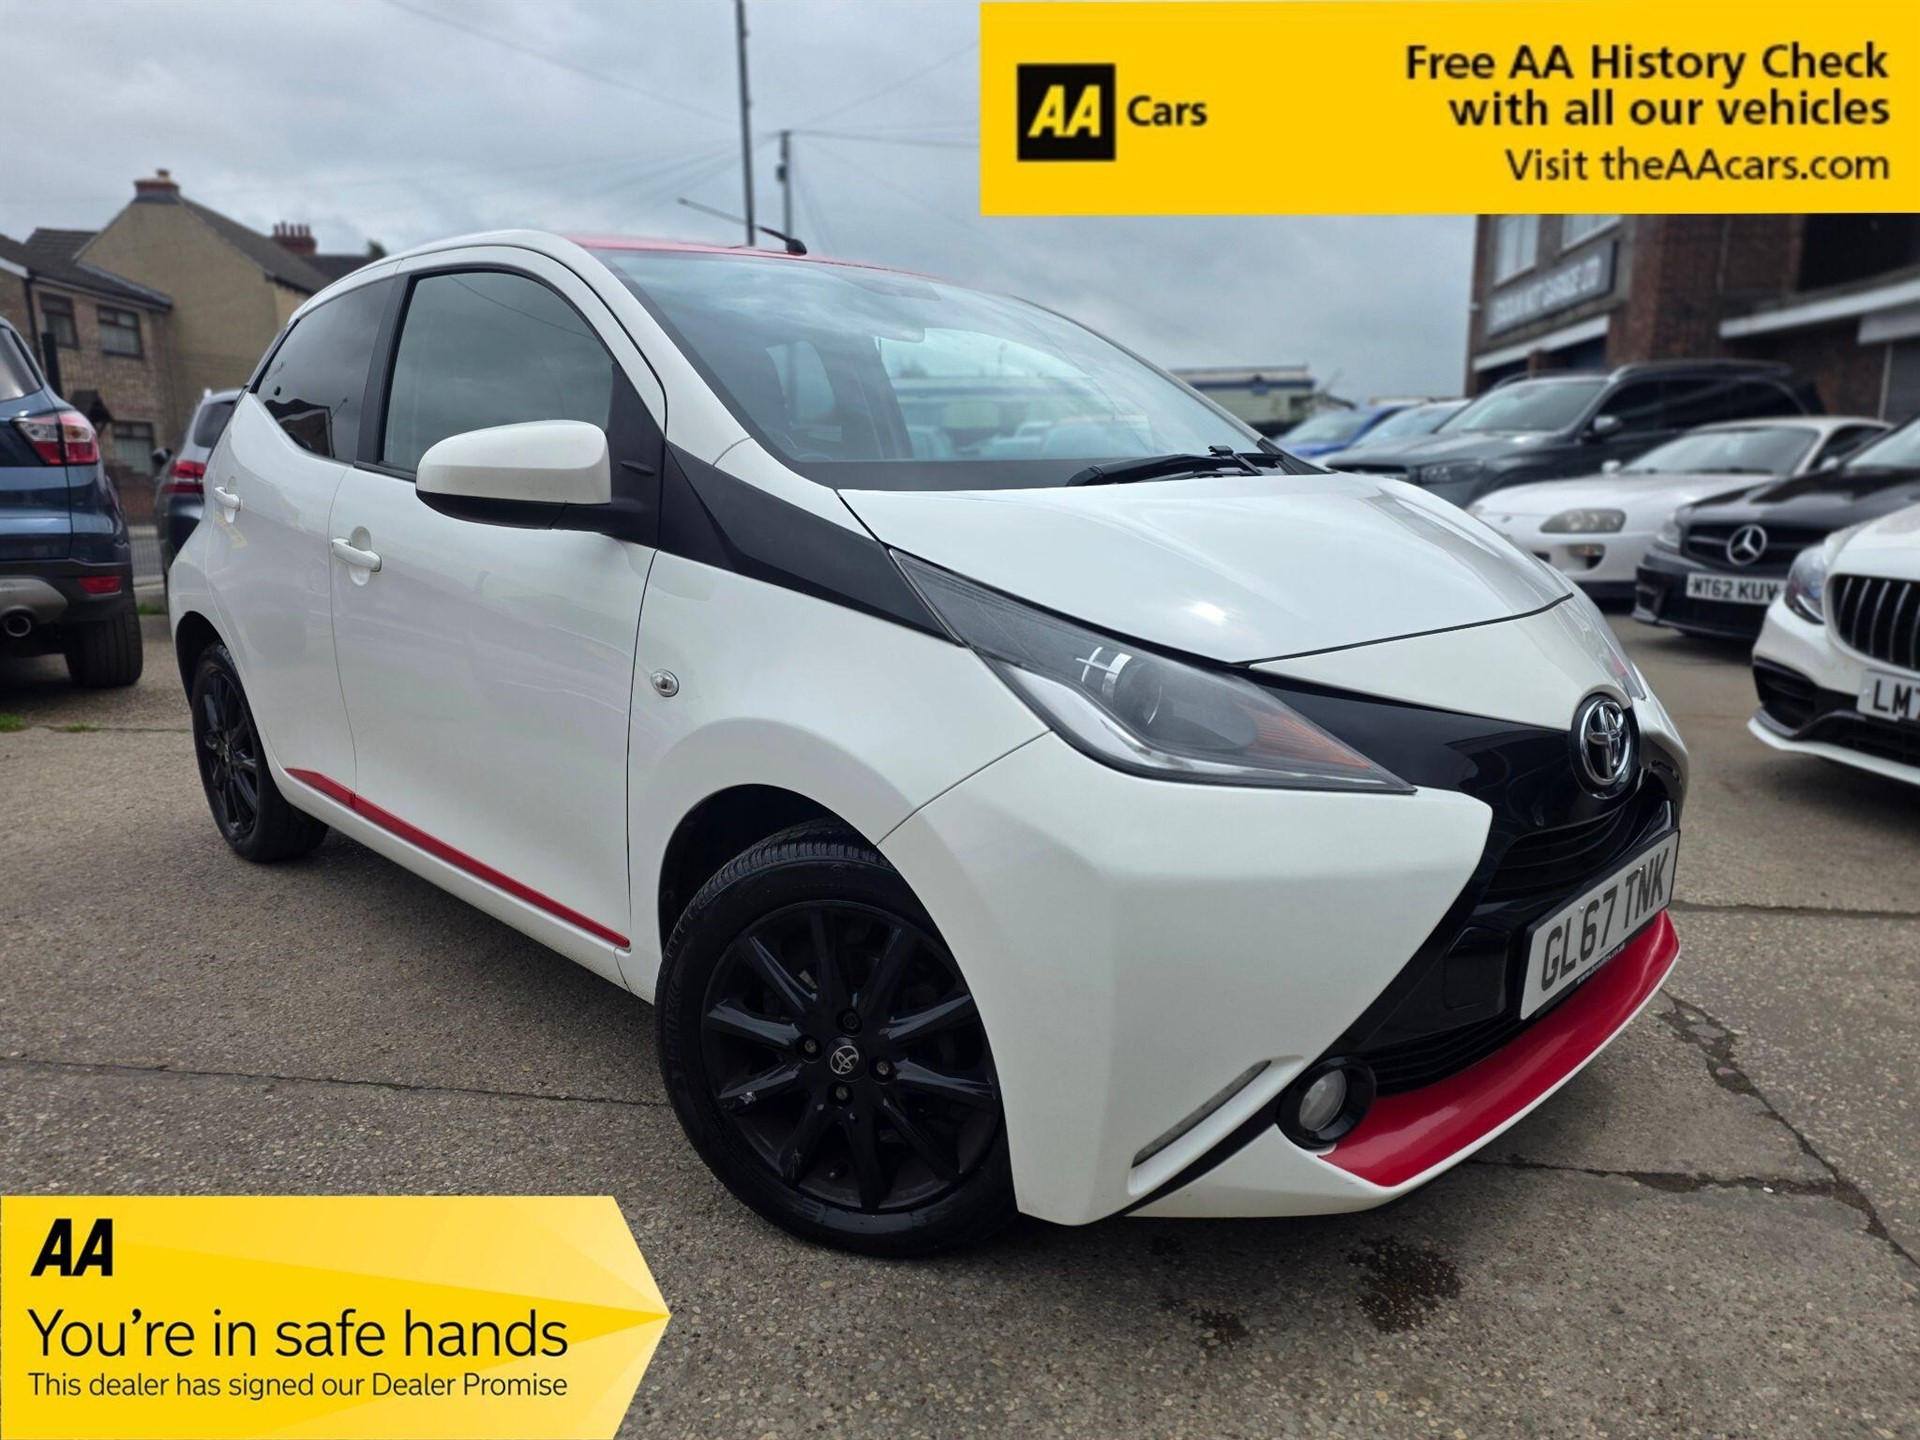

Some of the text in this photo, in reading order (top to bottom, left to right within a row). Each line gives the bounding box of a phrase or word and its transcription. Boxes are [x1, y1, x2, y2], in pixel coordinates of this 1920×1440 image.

[1873, 679, 1920, 721] LM
[1541, 885, 1619, 992] GL67
[1624, 848, 1670, 930] TNK
